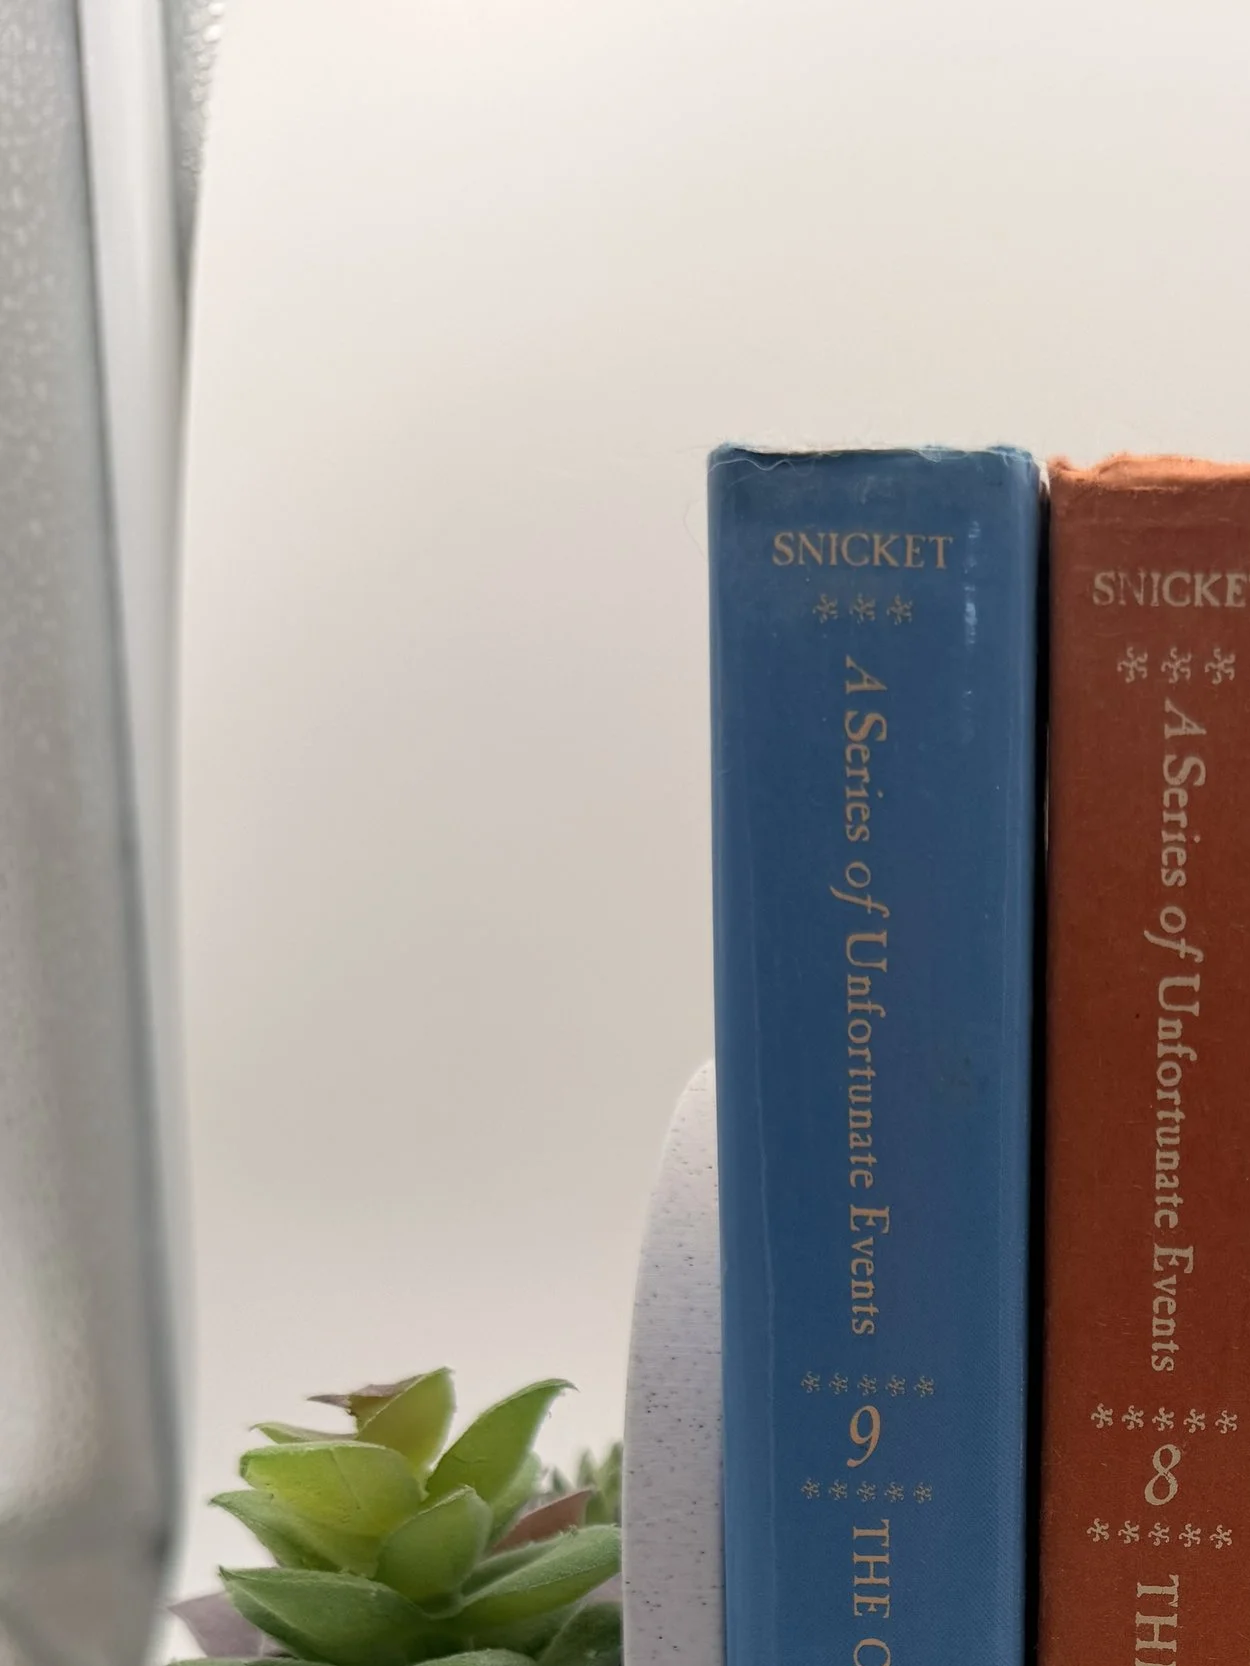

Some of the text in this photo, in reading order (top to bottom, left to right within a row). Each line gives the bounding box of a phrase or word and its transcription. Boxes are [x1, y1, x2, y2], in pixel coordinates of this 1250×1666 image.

[772, 531, 953, 569] SNICKET
[829, 654, 891, 1335] A Series of Unfortunate Events
[1143, 697, 1207, 1372] A Series of Unfortunate Events
[846, 1404, 881, 1468] 9
[1143, 1443, 1182, 1506] 8
[851, 1518, 891, 1619] THE
